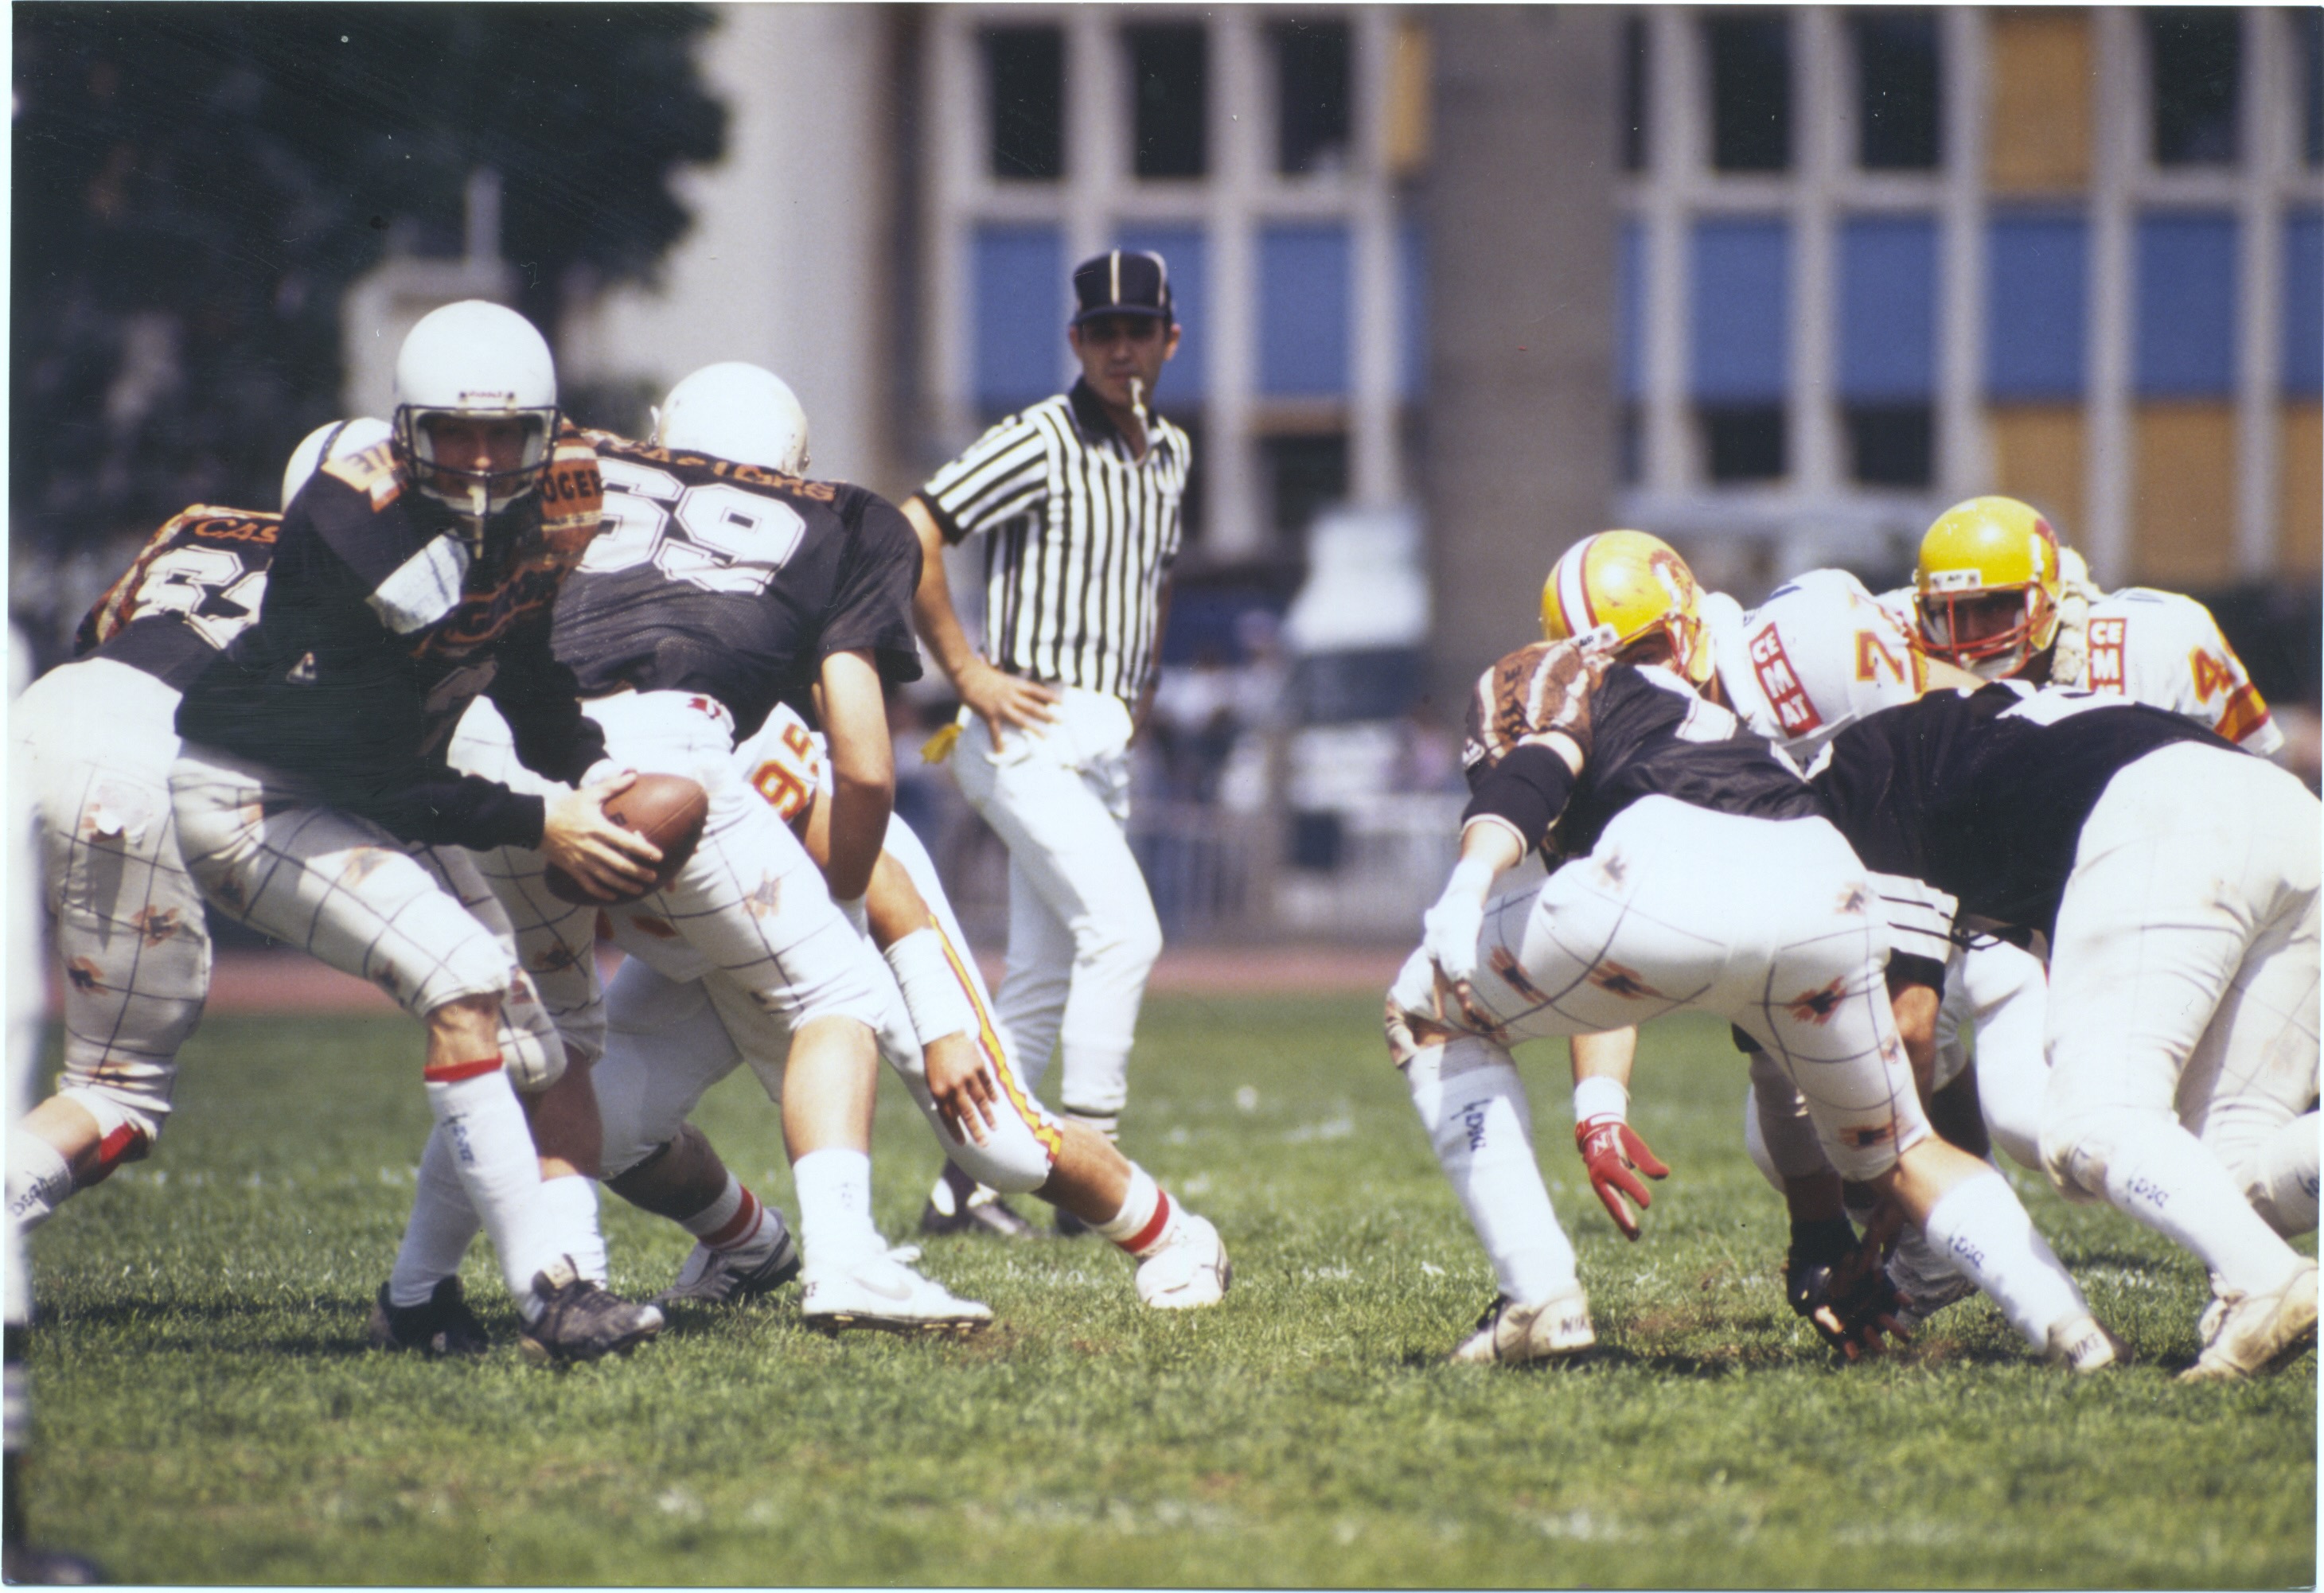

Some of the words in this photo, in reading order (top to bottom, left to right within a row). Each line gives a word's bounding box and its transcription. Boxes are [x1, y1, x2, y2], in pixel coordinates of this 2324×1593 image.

[575, 455, 807, 597] 69
[1751, 629, 1781, 664] CE
[2090, 621, 2123, 645] CE
[1761, 658, 1796, 699] M
[2092, 648, 2121, 680] M
[1780, 692, 1810, 728] AT
